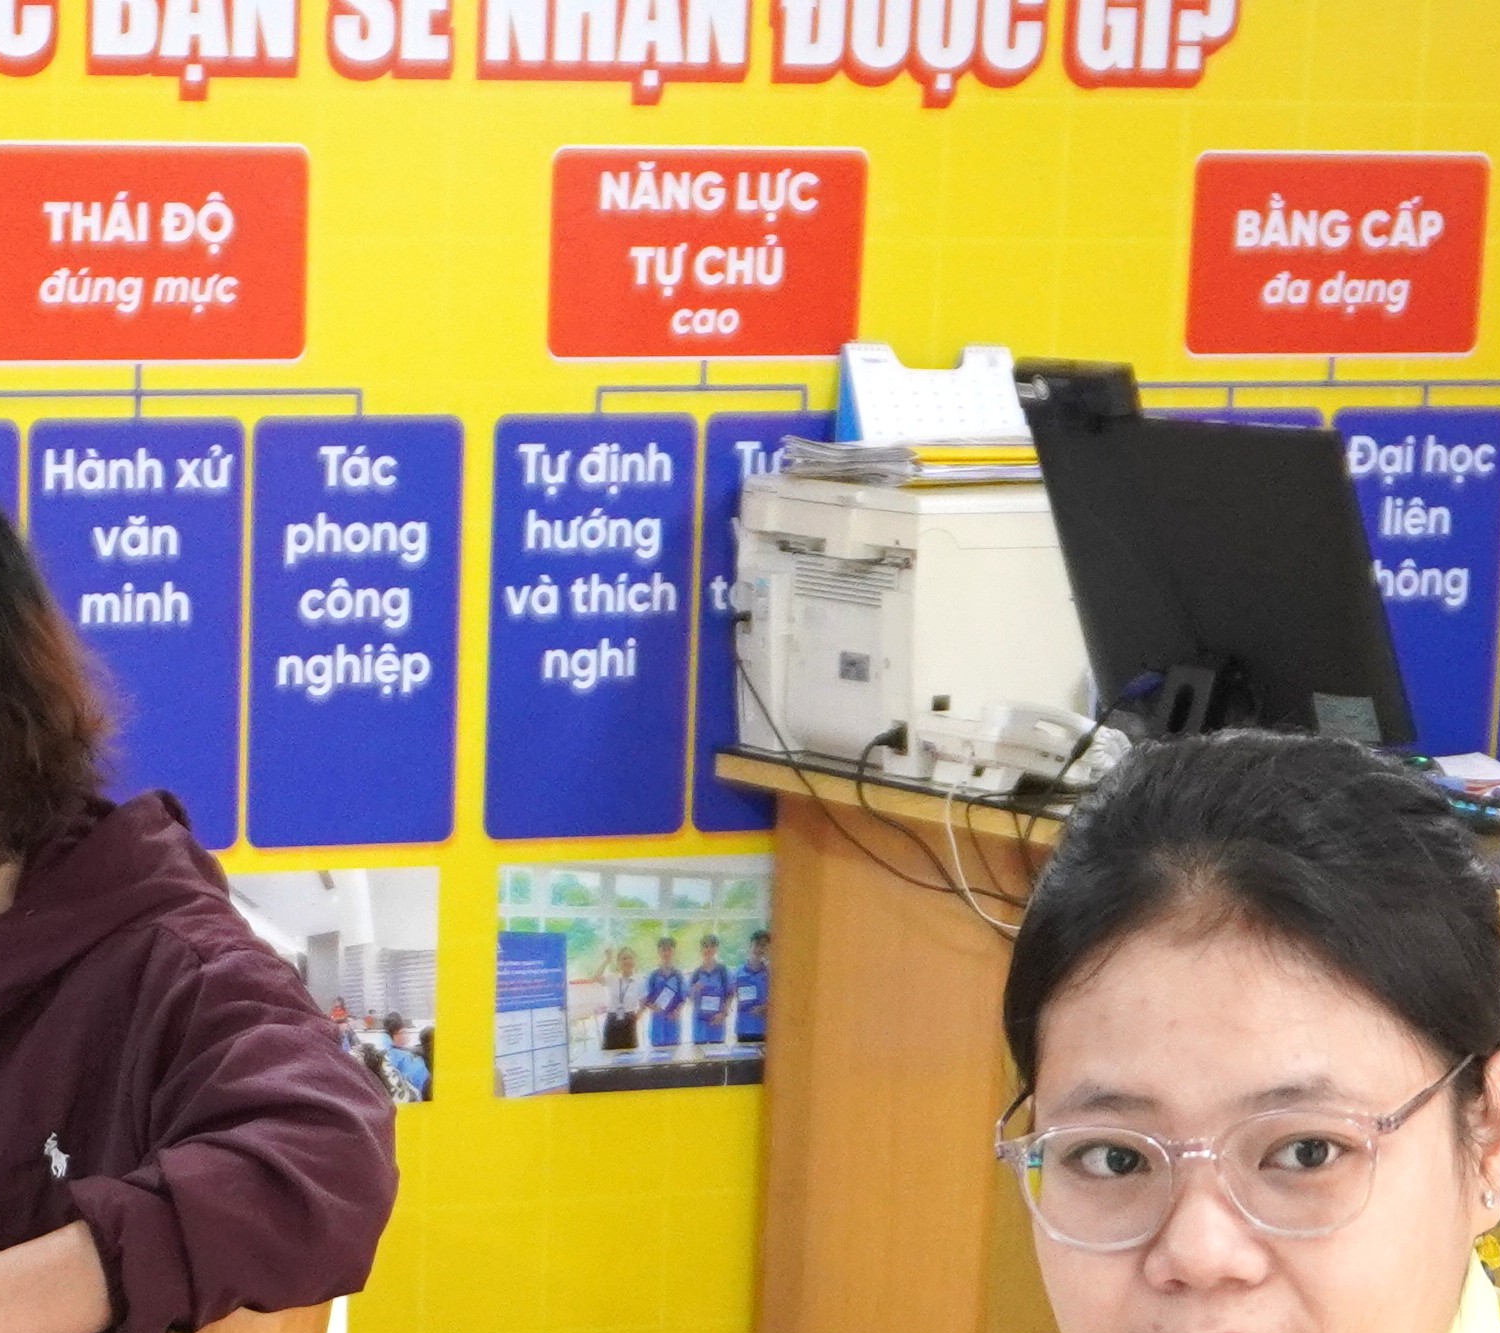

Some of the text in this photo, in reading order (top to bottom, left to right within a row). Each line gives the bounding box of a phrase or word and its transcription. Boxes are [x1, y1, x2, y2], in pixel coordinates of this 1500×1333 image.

[600, 167, 820, 222] NĂNG LỰC
[43, 190, 235, 256] THÁI ĐỘ
[1234, 193, 1446, 251] BẰNG CẤP
[40, 264, 238, 312] đúng mực
[630, 235, 786, 295] TỰ CHỦ
[1262, 270, 1412, 316] đa dạng
[670, 304, 741, 336] cao
[43, 443, 236, 491] Hành xử
[320, 444, 398, 489] Tác
[518, 442, 673, 498] Tự định
[1348, 436, 1496, 486] Đại học
[93, 517, 179, 557] văn
[284, 514, 428, 565] phong
[525, 509, 661, 560] hướng
[1381, 497, 1452, 537] liên
[80, 582, 190, 625] minh
[299, 578, 410, 629] công
[505, 575, 558, 617] và
[571, 572, 677, 615] thích
[1374, 560, 1470, 607] hông
[277, 644, 431, 694] nghiệp
[543, 638, 637, 690] nghi
